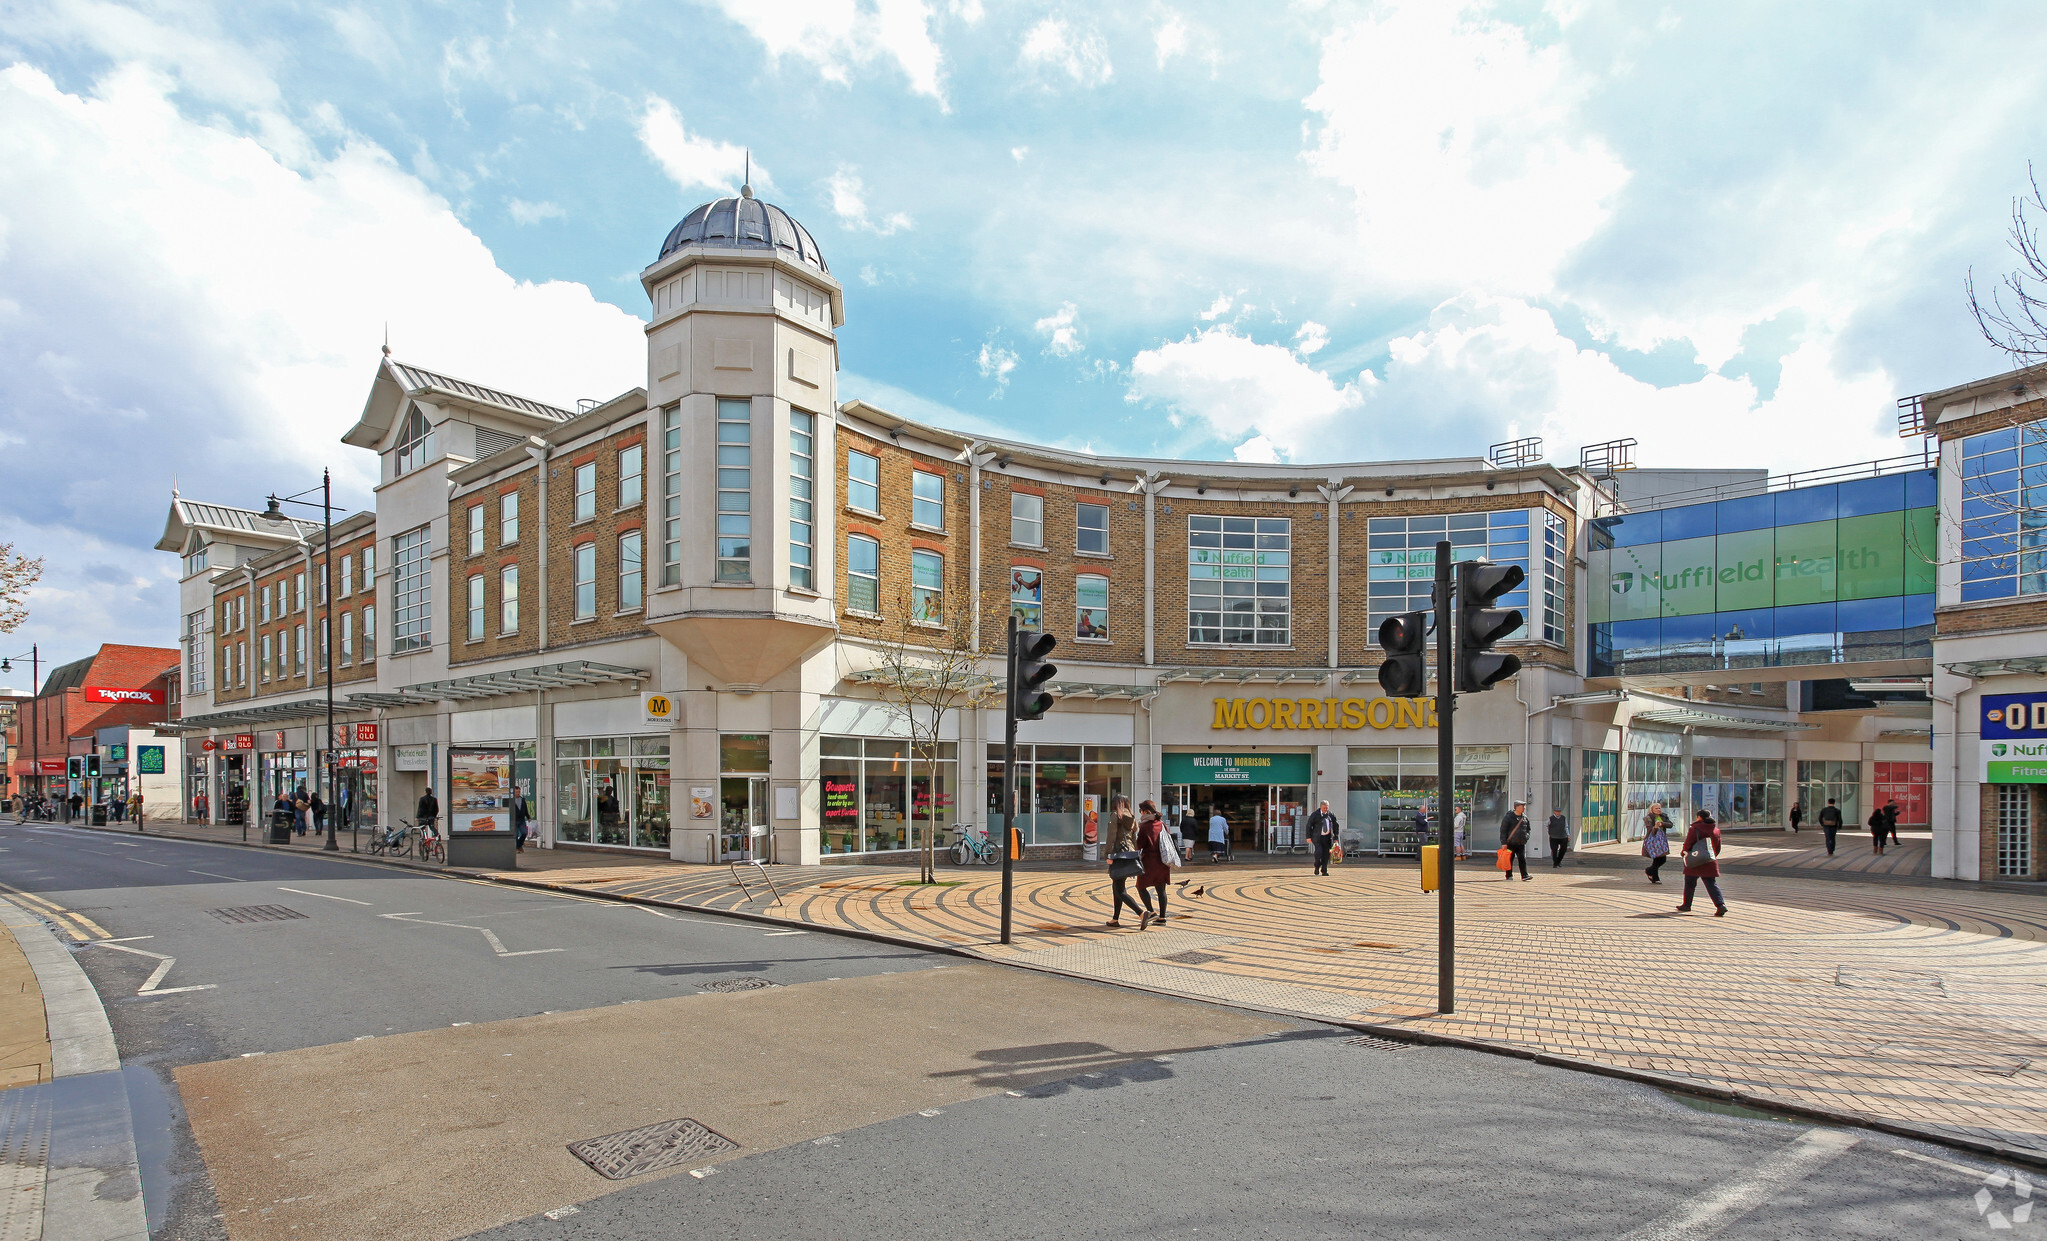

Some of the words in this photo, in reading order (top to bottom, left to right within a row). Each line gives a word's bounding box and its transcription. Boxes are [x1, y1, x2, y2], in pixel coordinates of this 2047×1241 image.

[1212, 552, 1265, 565] Nuffield
[1397, 551, 1457, 564] Nuffid
[1212, 566, 1253, 577] Health
[1397, 566, 1435, 577] Healt
[1640, 558, 1764, 592] Nuffield
[1776, 547, 1880, 578] Health
[652, 699, 667, 713] M
[1193, 757, 1223, 767] WELCOME
[1224, 757, 1233, 767] TO
[1234, 757, 1271, 767] MORRISONS
[825, 781, 856, 794] Bouquets
[842, 800, 848, 808] by
[825, 809, 841, 818] expert
